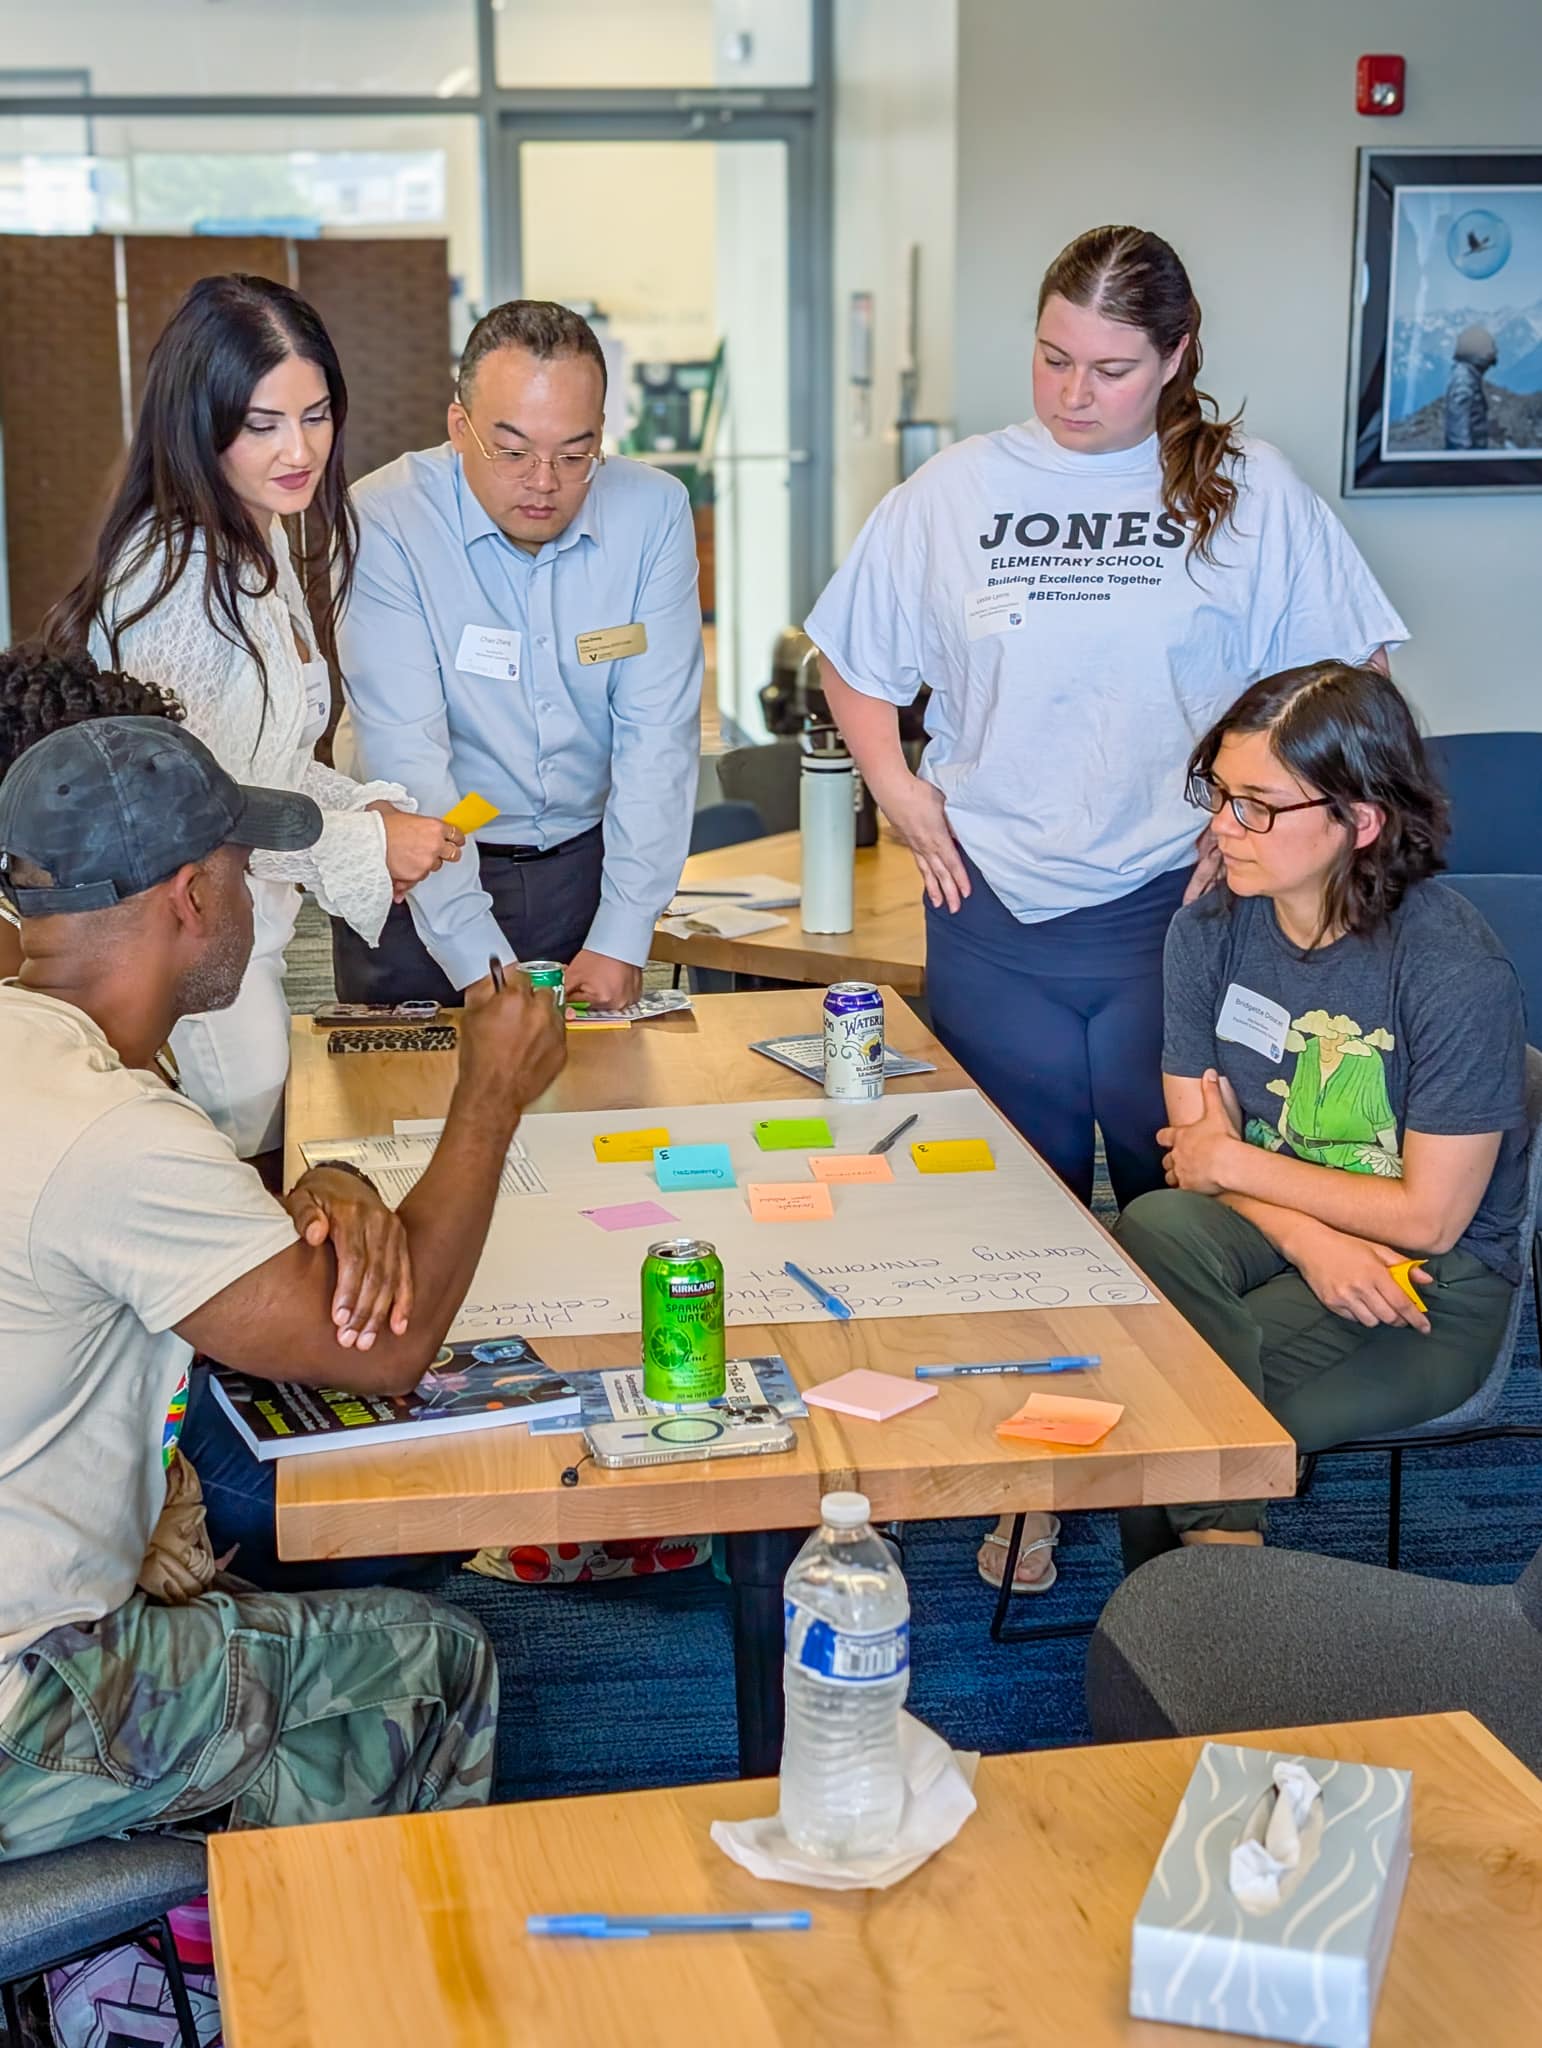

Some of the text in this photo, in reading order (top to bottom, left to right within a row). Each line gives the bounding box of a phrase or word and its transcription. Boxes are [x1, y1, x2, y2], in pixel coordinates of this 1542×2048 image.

[979, 511, 1186, 550] JONES
[990, 555, 1165, 570] ELEMENTARY SCHOOL
[987, 574, 1162, 587] Building Excellence Together
[1028, 591, 1111, 601] #BETonJones
[738, 1245, 1101, 1282] learning environmnt
[1087, 1263, 1123, 1278] to
[671, 1281, 716, 1293] KIRKLAND
[891, 1271, 1041, 1290] describe
[946, 1285, 1070, 1305] One
[463, 1298, 610, 1313] centere
[677, 1311, 712, 1324] WATER
